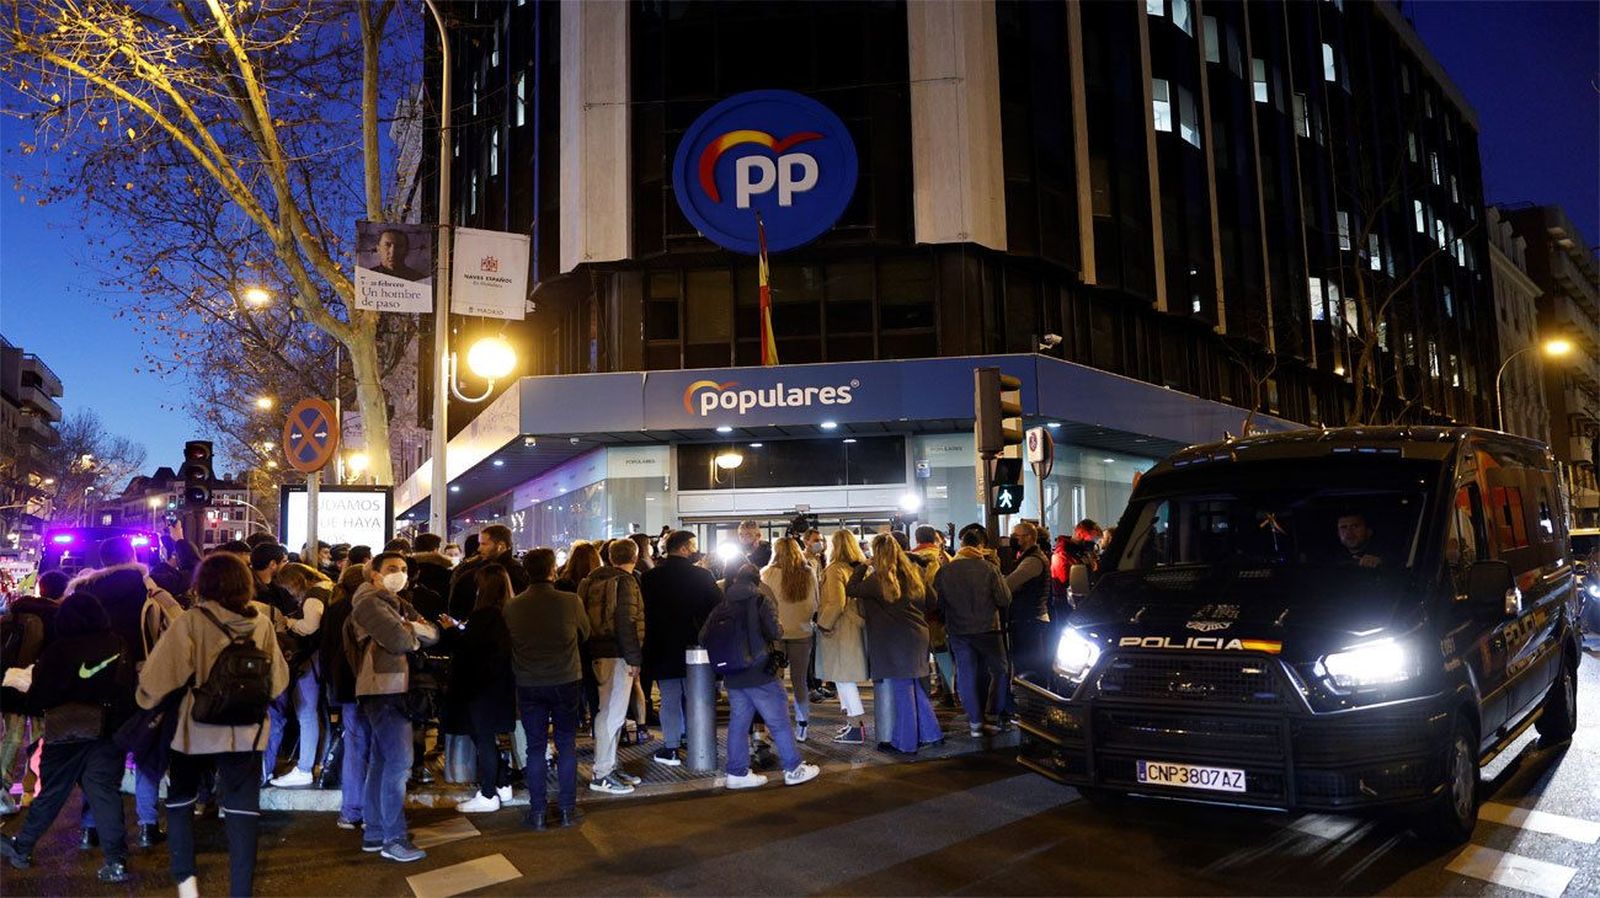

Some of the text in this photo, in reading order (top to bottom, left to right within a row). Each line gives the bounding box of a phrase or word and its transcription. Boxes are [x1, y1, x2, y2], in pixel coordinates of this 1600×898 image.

[378, 280, 405, 288] febrero
[361, 287, 422, 300] Un hombre
[361, 296, 401, 309] de paso
[343, 517, 382, 529] HAYA
[1118, 636, 1244, 650] POLICIA
[1147, 764, 1243, 789] CNP3807AZ
